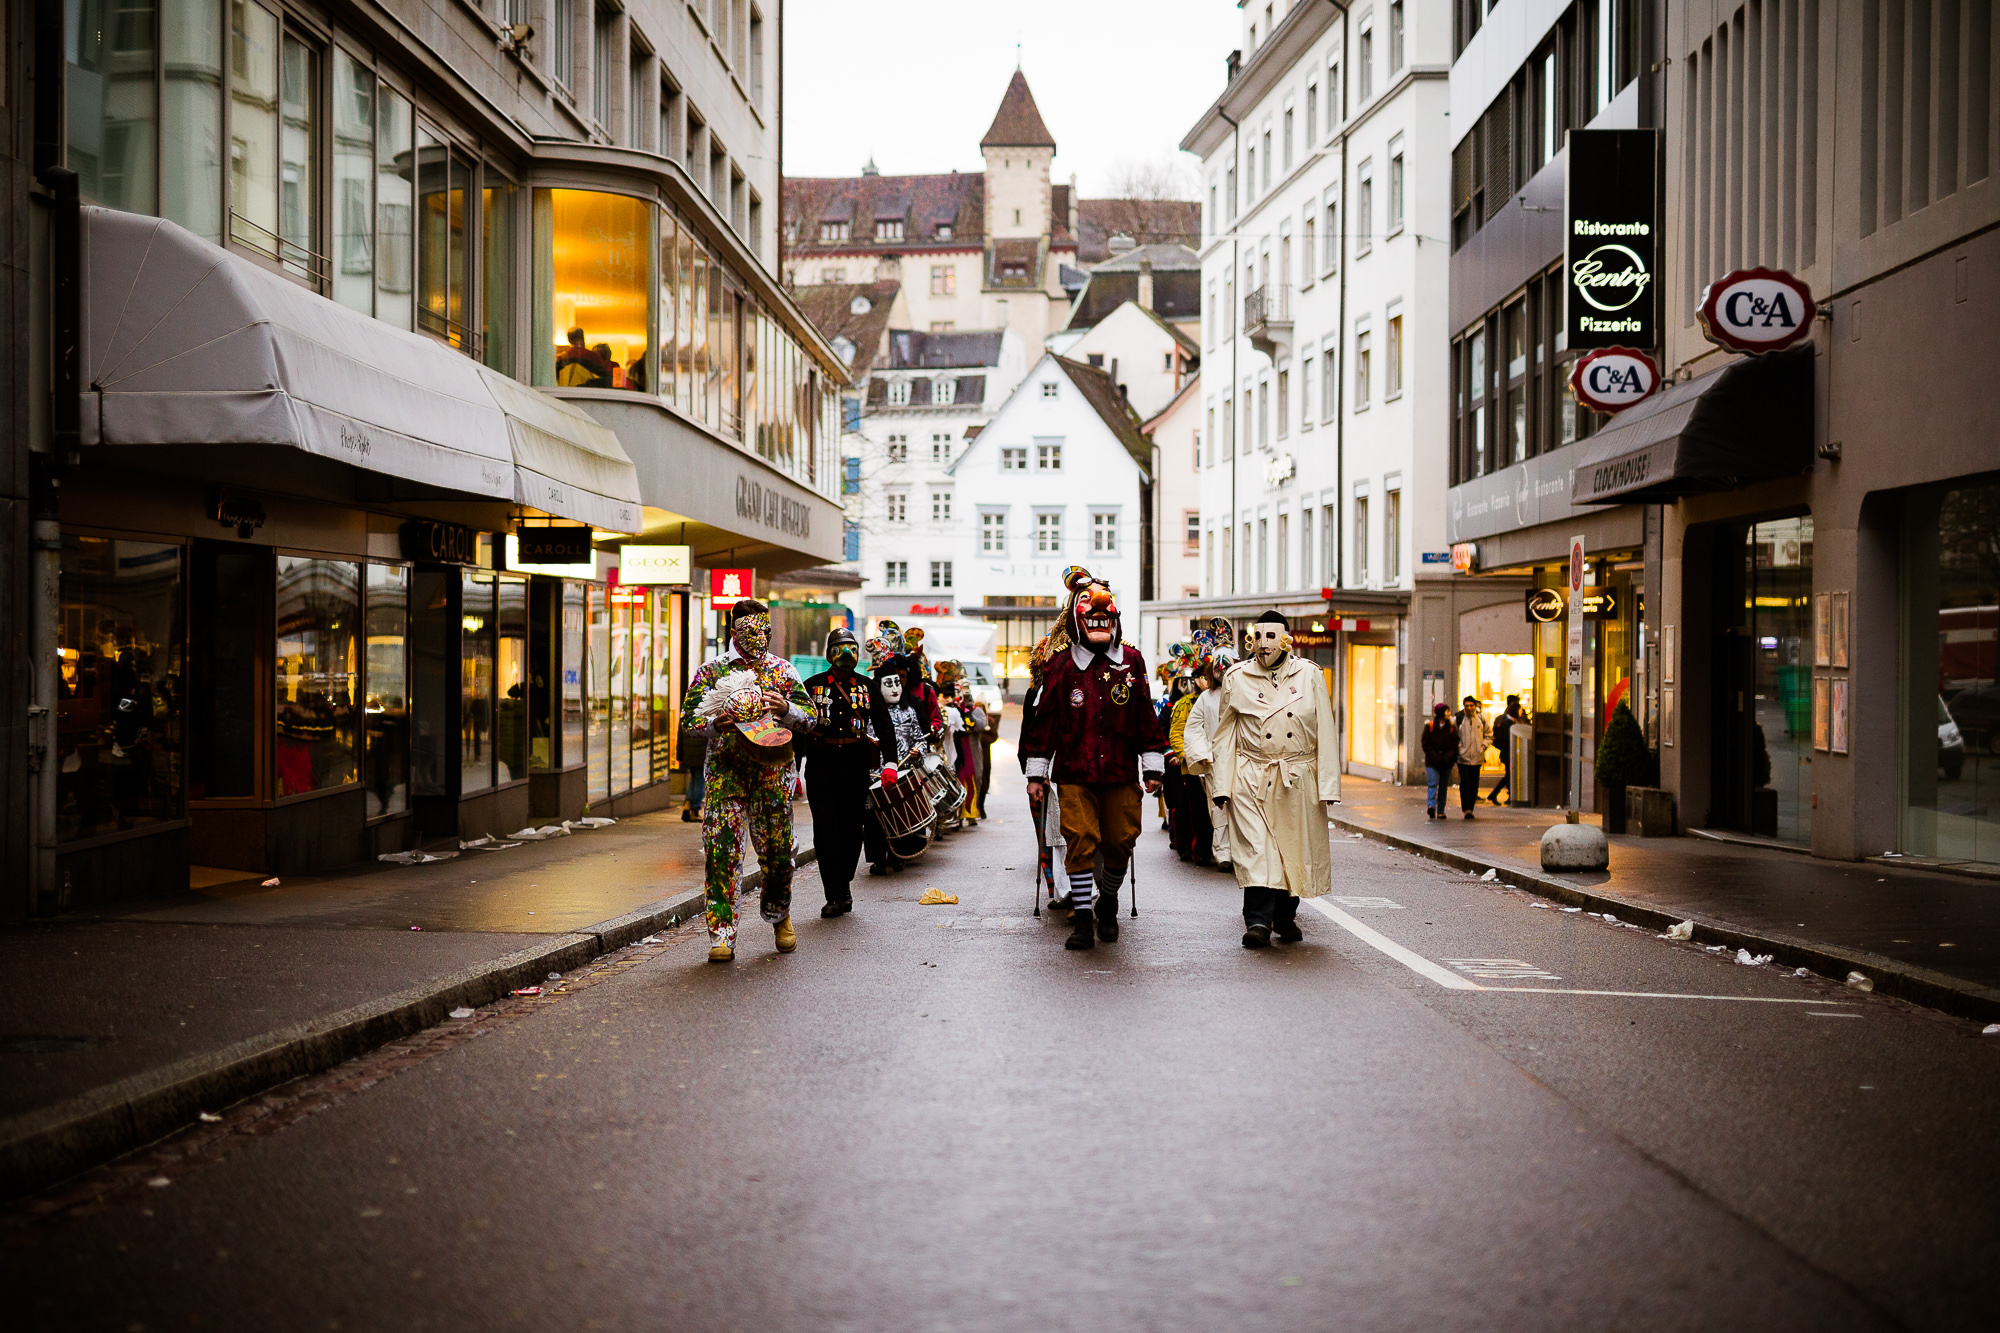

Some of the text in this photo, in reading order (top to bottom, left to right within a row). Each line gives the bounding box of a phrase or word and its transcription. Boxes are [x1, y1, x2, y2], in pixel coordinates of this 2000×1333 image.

[1574, 219, 1650, 236] Ristorante
[1572, 259, 1651, 288] Centro
[1725, 291, 1796, 328] C&A
[1580, 316, 1642, 332] Pizzeria
[1589, 365, 1646, 394] C&A
[1593, 454, 1647, 494] CLOCKHOUSE
[522, 543, 583, 556] CAROLL
[628, 556, 681, 568] GEOX
[1294, 633, 1333, 646] Vögele
